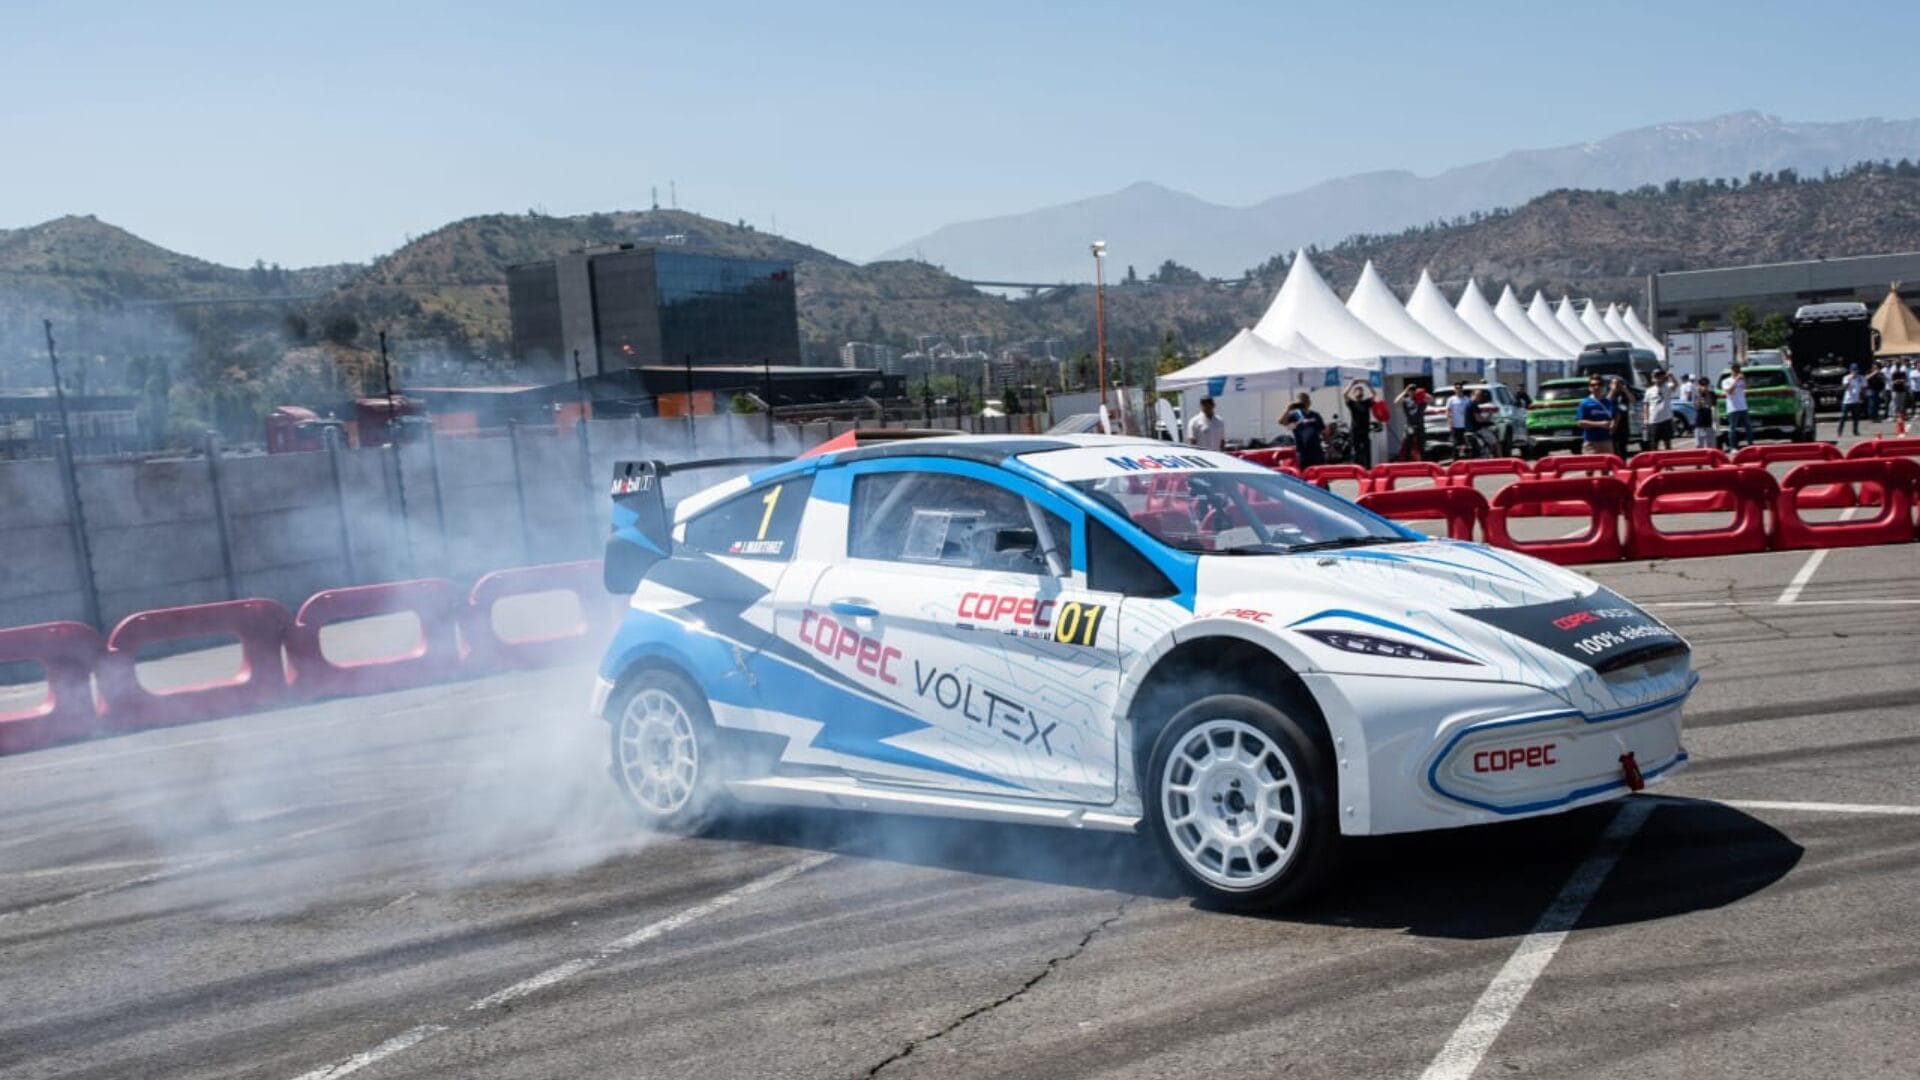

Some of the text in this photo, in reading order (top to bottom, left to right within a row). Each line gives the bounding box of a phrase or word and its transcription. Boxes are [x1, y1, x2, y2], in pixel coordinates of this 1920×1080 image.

[1104, 455, 1195, 470] Mobil
[757, 484, 782, 540] 1
[958, 592, 1057, 628] COPEC
[1057, 601, 1102, 647] 01
[798, 608, 903, 685] COPEC
[1573, 631, 1626, 656] 100%
[914, 659, 1057, 756] VOLTEX
[1473, 743, 1557, 773] COPEC
